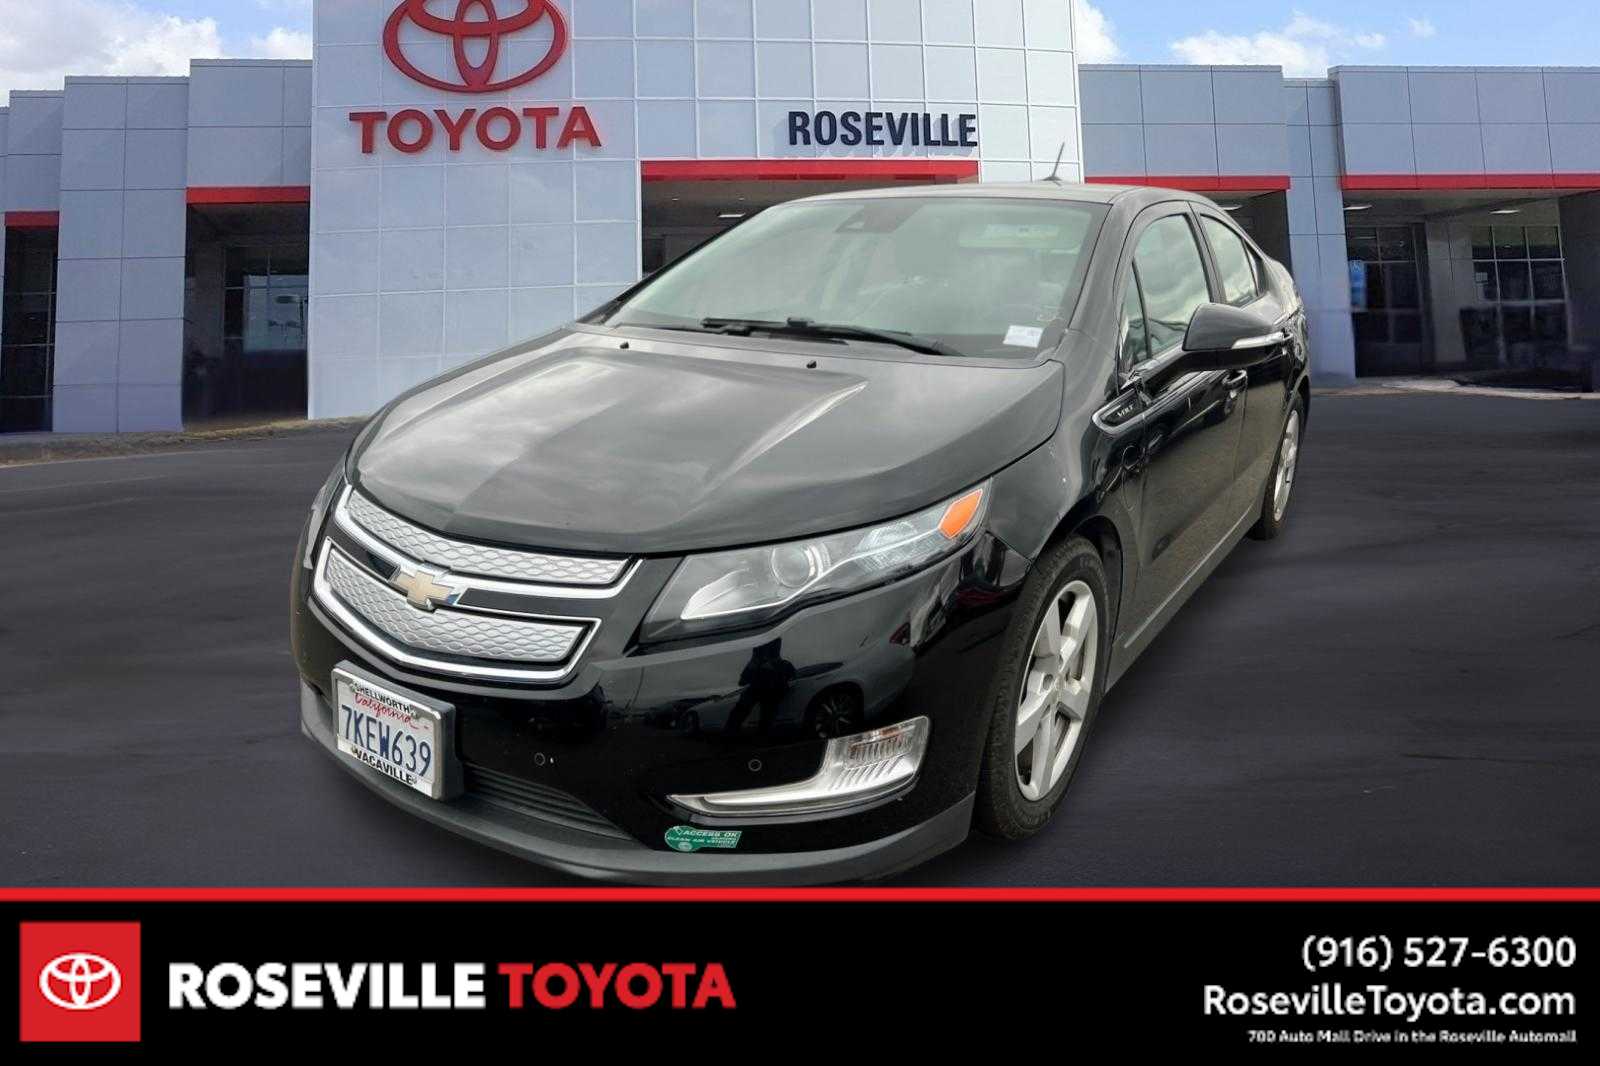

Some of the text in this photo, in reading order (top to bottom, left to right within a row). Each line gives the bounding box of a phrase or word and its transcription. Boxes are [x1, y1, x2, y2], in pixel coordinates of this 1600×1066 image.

[349, 106, 602, 154] TOYOTA
[788, 111, 978, 147] ROSEVILLE
[354, 692, 417, 727] California
[341, 704, 431, 777] 7KEW639
[355, 748, 414, 785] VACAVILLE
